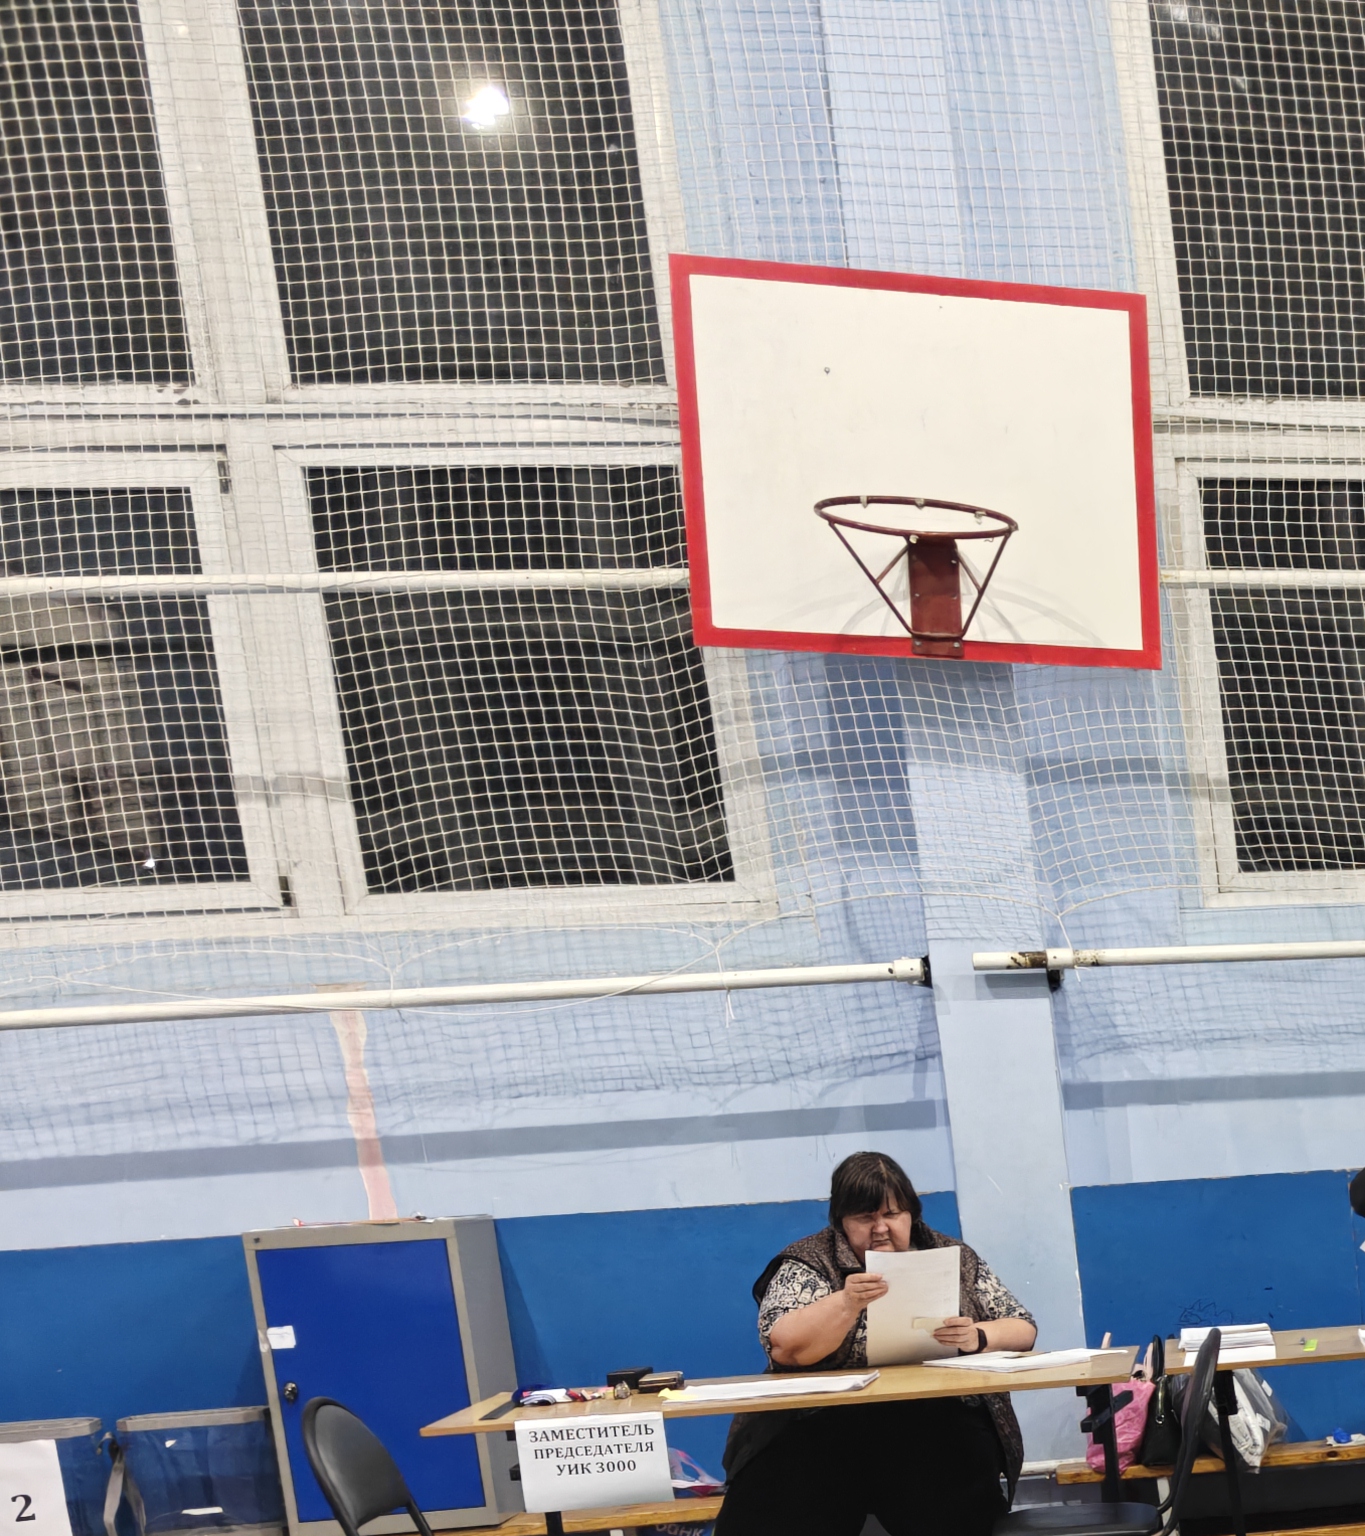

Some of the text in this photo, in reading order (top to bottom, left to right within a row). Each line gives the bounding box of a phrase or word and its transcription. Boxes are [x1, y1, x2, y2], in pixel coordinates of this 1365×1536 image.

[528, 1423, 655, 1443] ЗАМЕСТИТЕЛЬ
[534, 1441, 655, 1460] ПРЕДСЕДАТЕЛЯ
[556, 1459, 637, 1476] УИК 3000
[10, 1494, 36, 1522] 2
